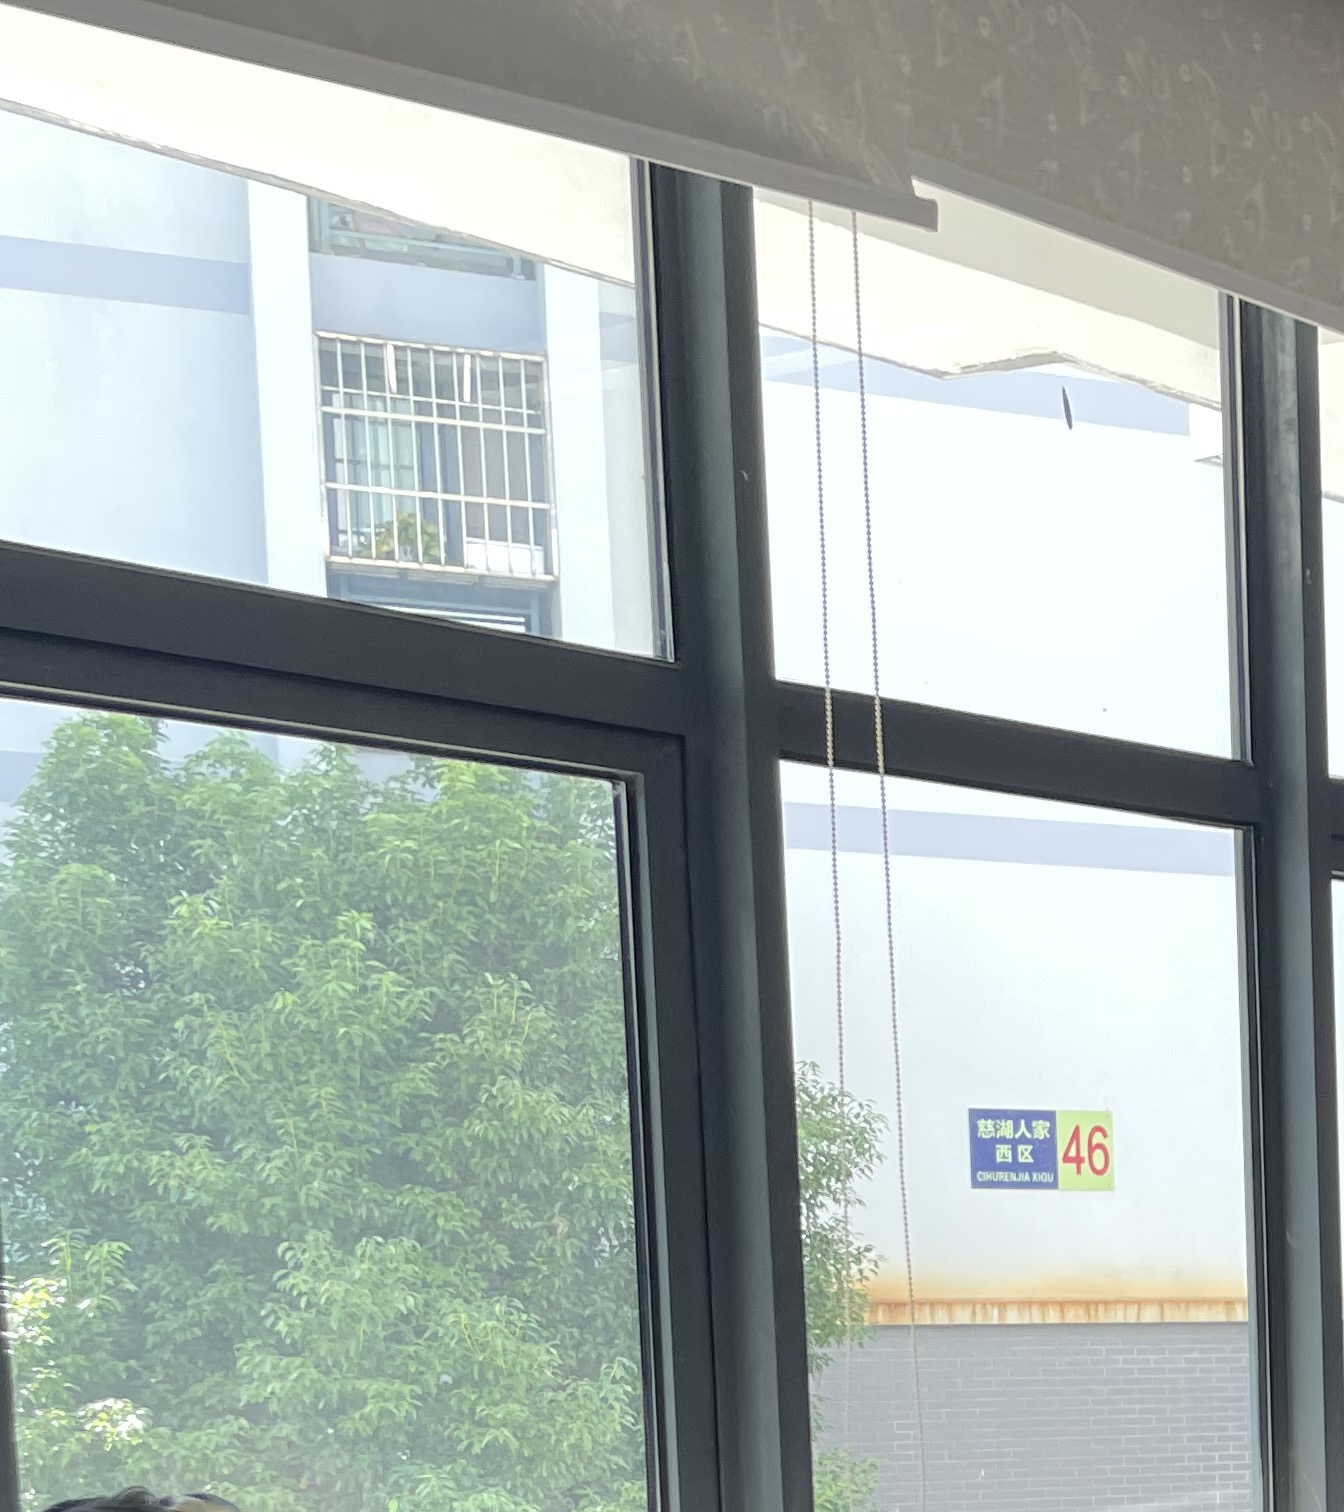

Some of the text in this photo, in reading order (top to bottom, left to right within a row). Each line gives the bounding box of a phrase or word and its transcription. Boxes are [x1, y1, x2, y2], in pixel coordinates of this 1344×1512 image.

[976, 1118, 1051, 1140] 慈湖人家
[995, 1144, 1035, 1164] 西区
[1061, 1124, 1110, 1176] 46
